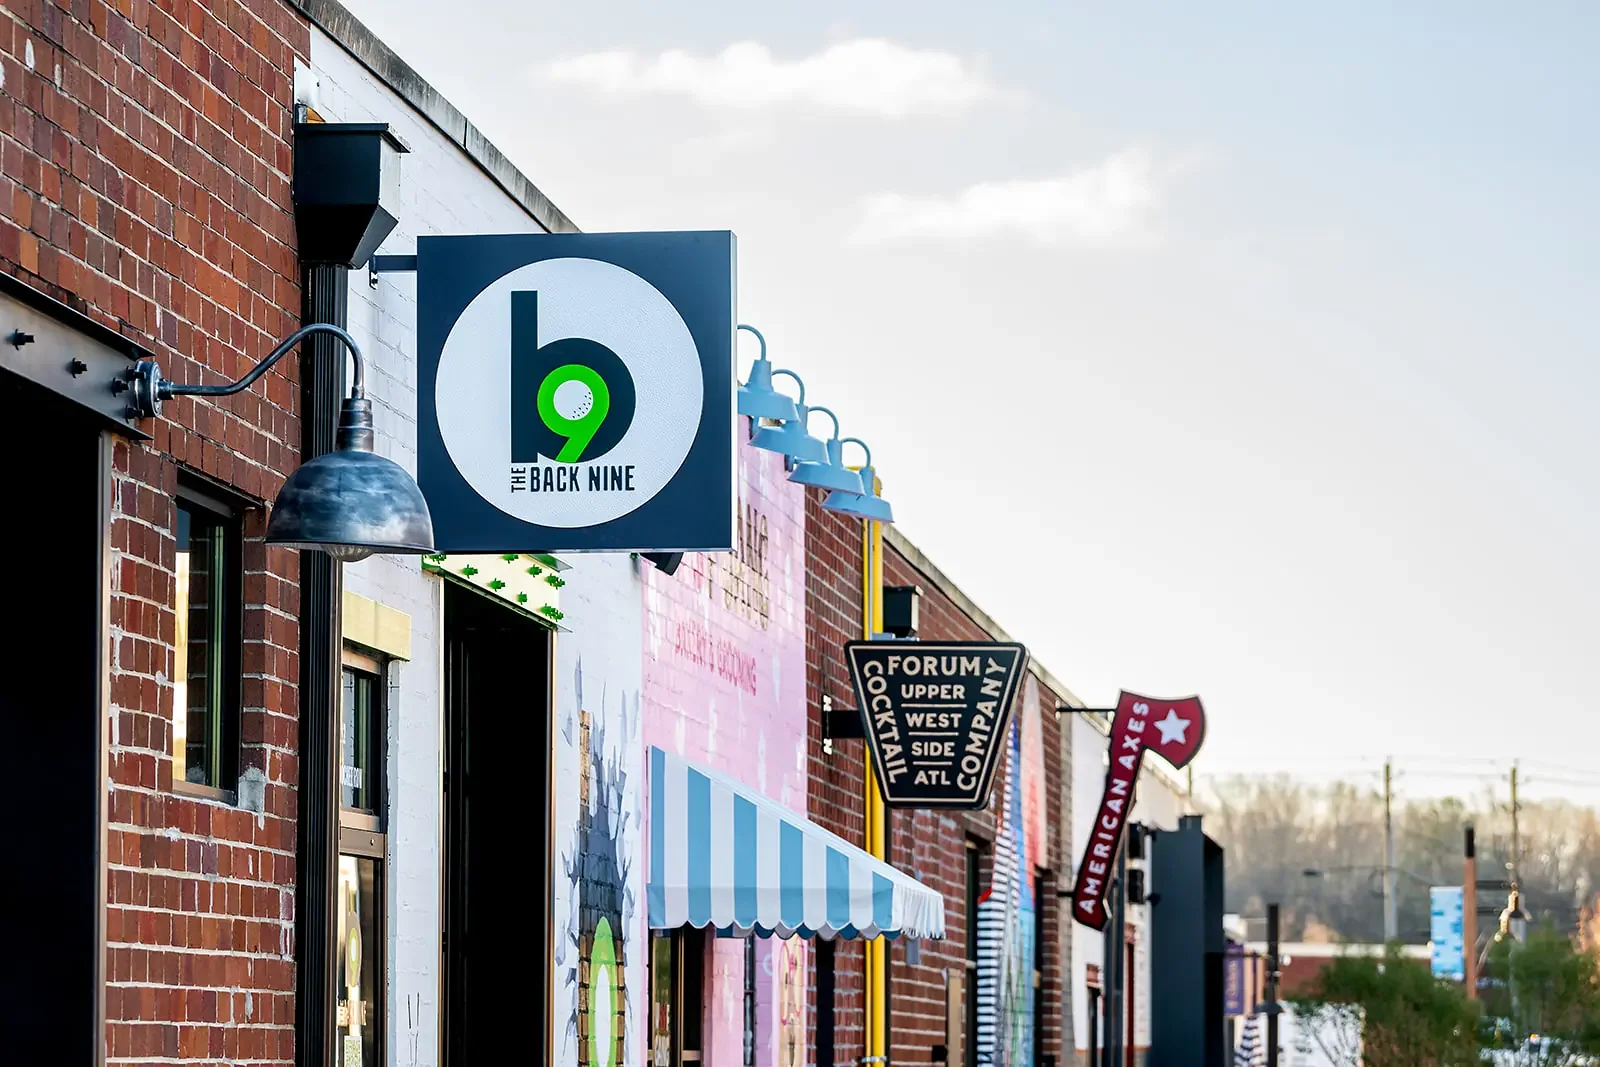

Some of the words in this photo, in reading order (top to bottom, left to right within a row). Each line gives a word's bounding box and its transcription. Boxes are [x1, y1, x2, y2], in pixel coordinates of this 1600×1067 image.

[511, 467, 526, 493] THE
[530, 466, 580, 492] BACK
[588, 465, 635, 491] NINE
[887, 655, 981, 677] FORUM
[901, 684, 966, 699] UPPER
[863, 660, 908, 784] COCKTAIL
[905, 712, 962, 728] WEST
[956, 657, 1007, 791] COMPANY
[911, 741, 955, 757] SIDE
[914, 770, 951, 785] ATL
[1078, 778, 1129, 914] AMERICAN
[1118, 701, 1150, 770] AXES
